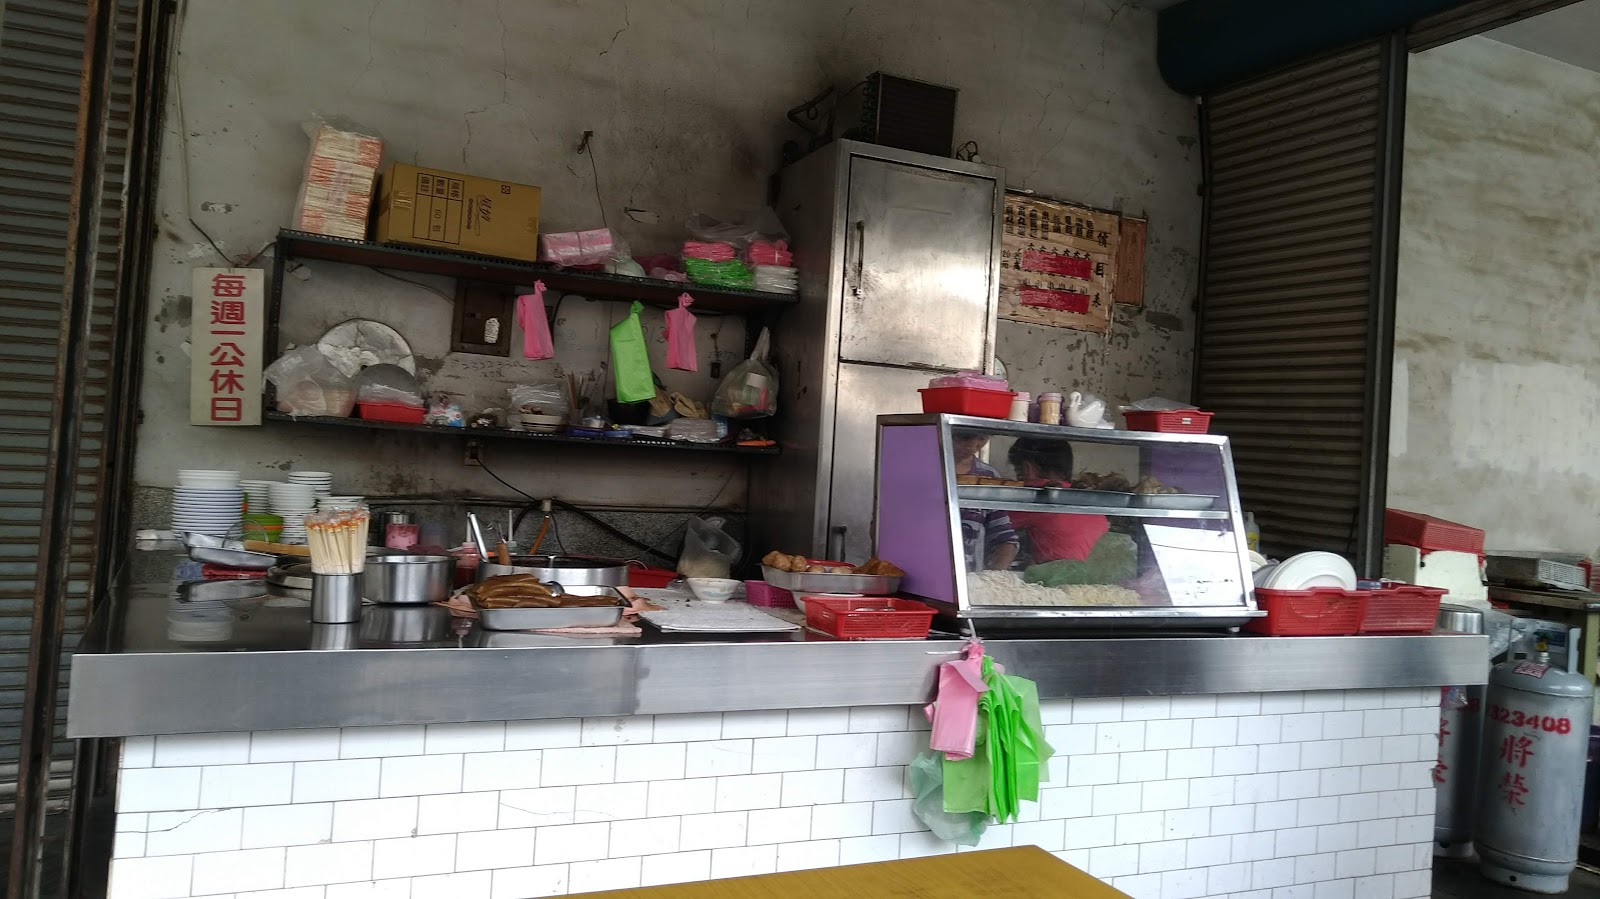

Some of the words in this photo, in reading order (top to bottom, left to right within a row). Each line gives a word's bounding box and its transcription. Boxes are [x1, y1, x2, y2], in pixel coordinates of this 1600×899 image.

[209, 273, 246, 421] 每週一公休日
